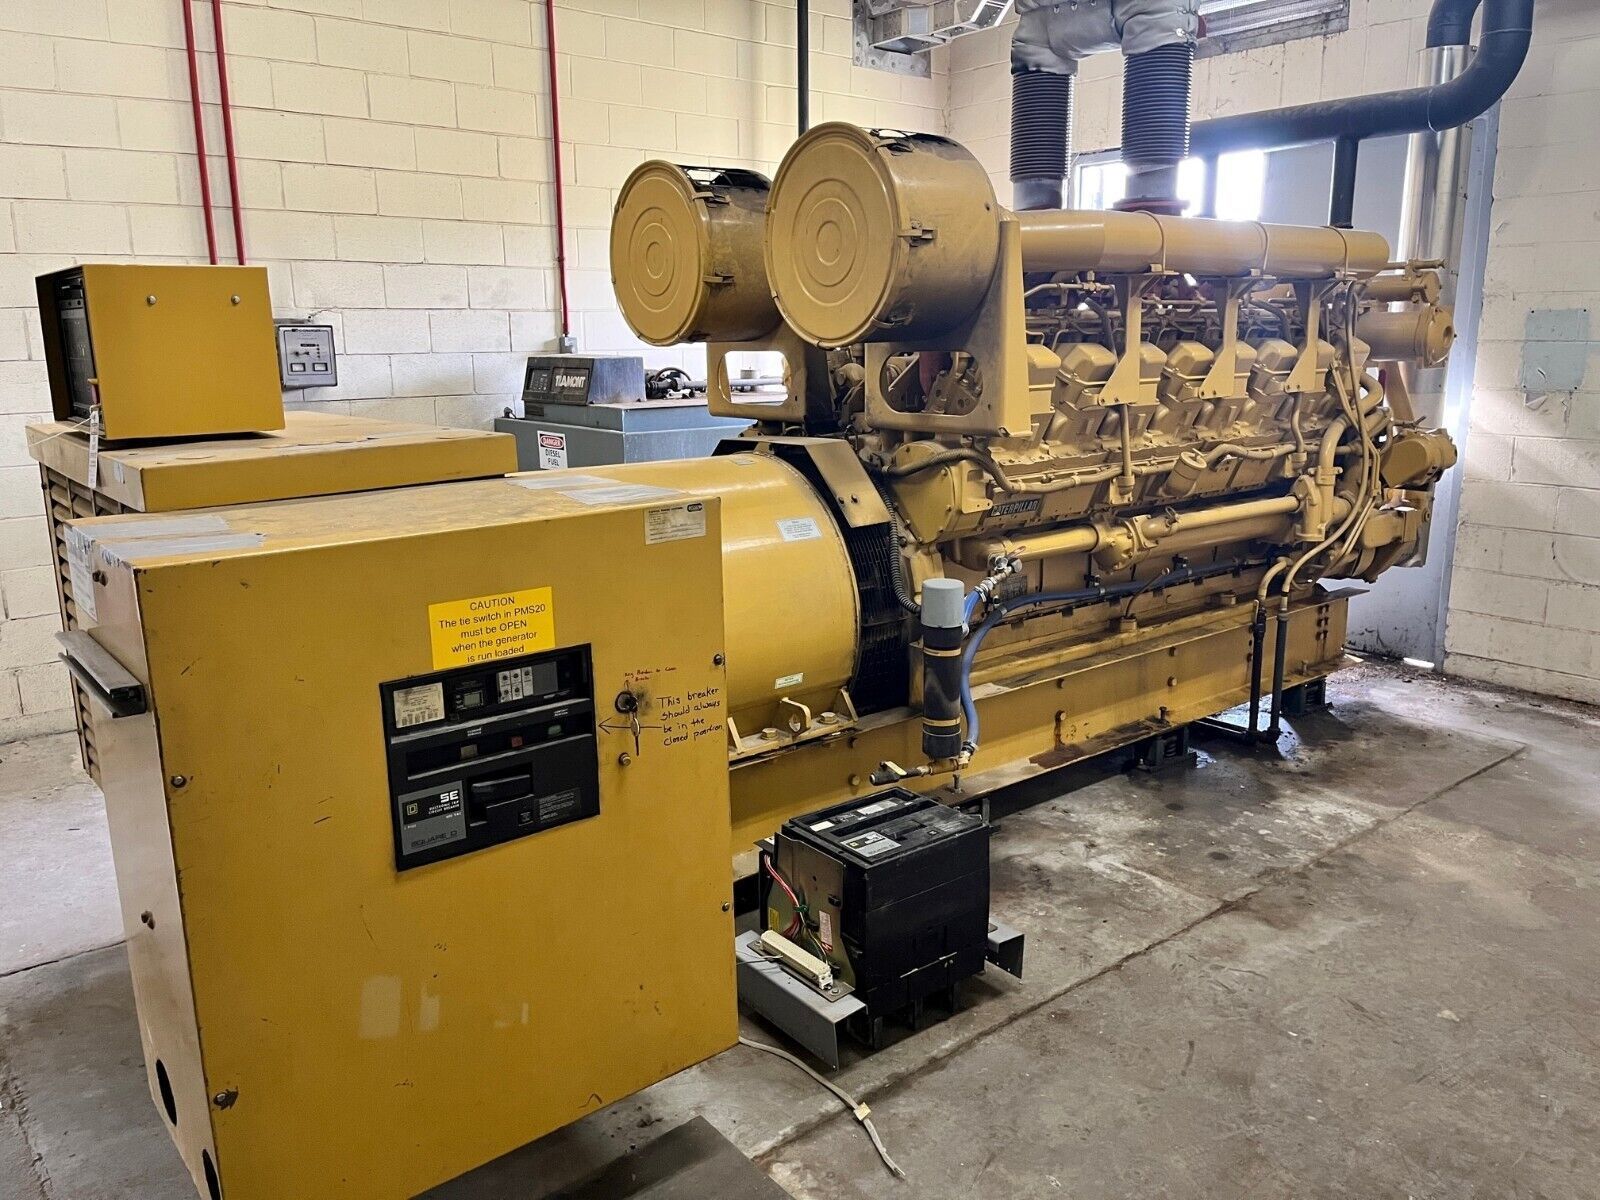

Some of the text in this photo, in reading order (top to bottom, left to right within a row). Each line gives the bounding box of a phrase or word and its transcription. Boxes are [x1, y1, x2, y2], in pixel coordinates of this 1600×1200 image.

[542, 437, 561, 446] DANGER
[545, 449, 560, 458] DIESEL
[548, 457, 560, 466] FUEL
[991, 500, 1039, 516] CATERPILLAR
[470, 597, 515, 611] CAUTION
[440, 620, 456, 629] The
[460, 617, 470, 625] tie
[473, 612, 501, 623] switch
[514, 604, 546, 616] PMS20
[461, 620, 527, 638] must be OPEN
[451, 631, 537, 653] when the generator
[478, 652, 492, 660] run
[495, 645, 524, 657] loaded
[656, 686, 719, 708] This breaker
[693, 701, 720, 711] always
[663, 724, 672, 733] be
[691, 718, 705, 726] the
[440, 790, 458, 803] SE
